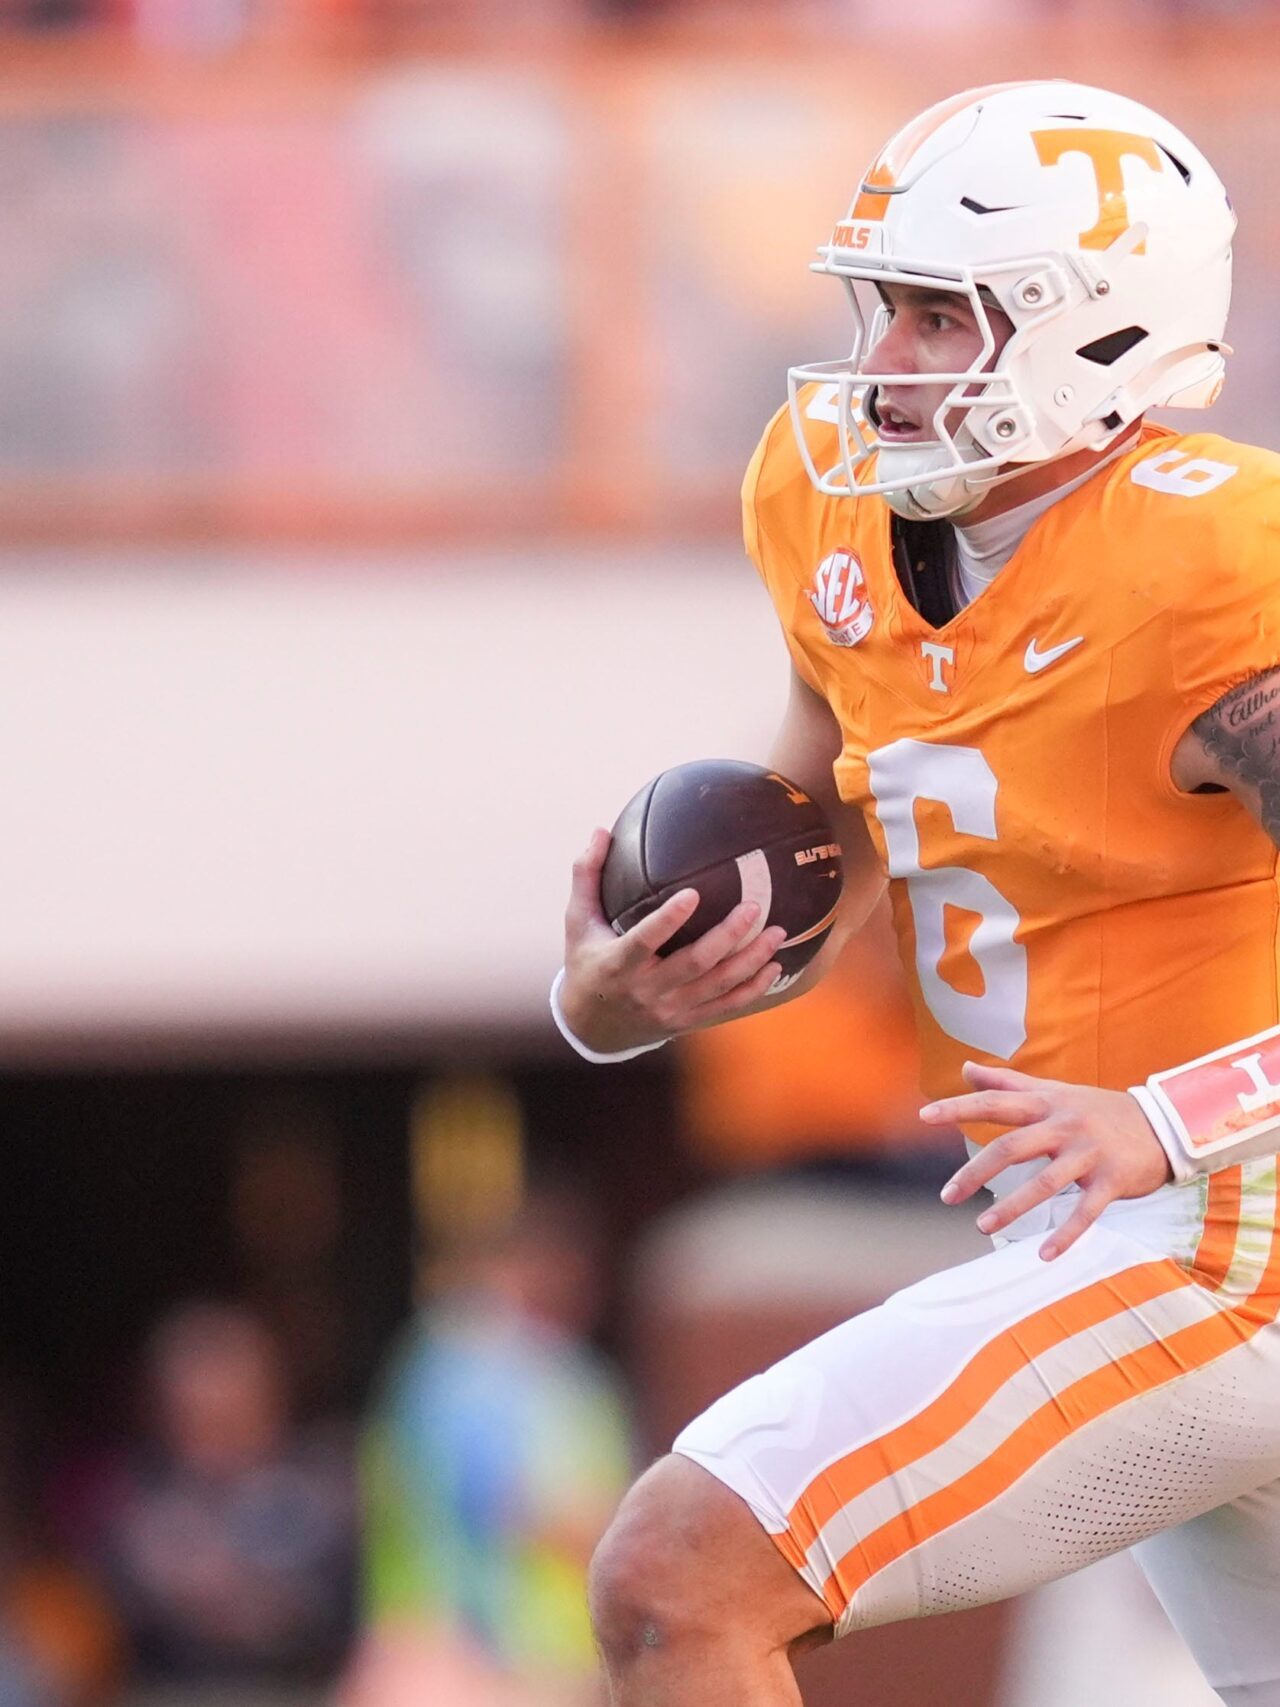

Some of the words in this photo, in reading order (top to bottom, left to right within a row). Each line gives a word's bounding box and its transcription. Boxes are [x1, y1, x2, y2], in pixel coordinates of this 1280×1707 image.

[1029, 128, 1163, 256] T
[831, 225, 871, 250] VOLS
[1130, 450, 1239, 497] 6
[810, 552, 864, 624] SEC
[920, 641, 954, 692] T
[1249, 710, 1276, 740] not
[866, 737, 1028, 1061] 6
